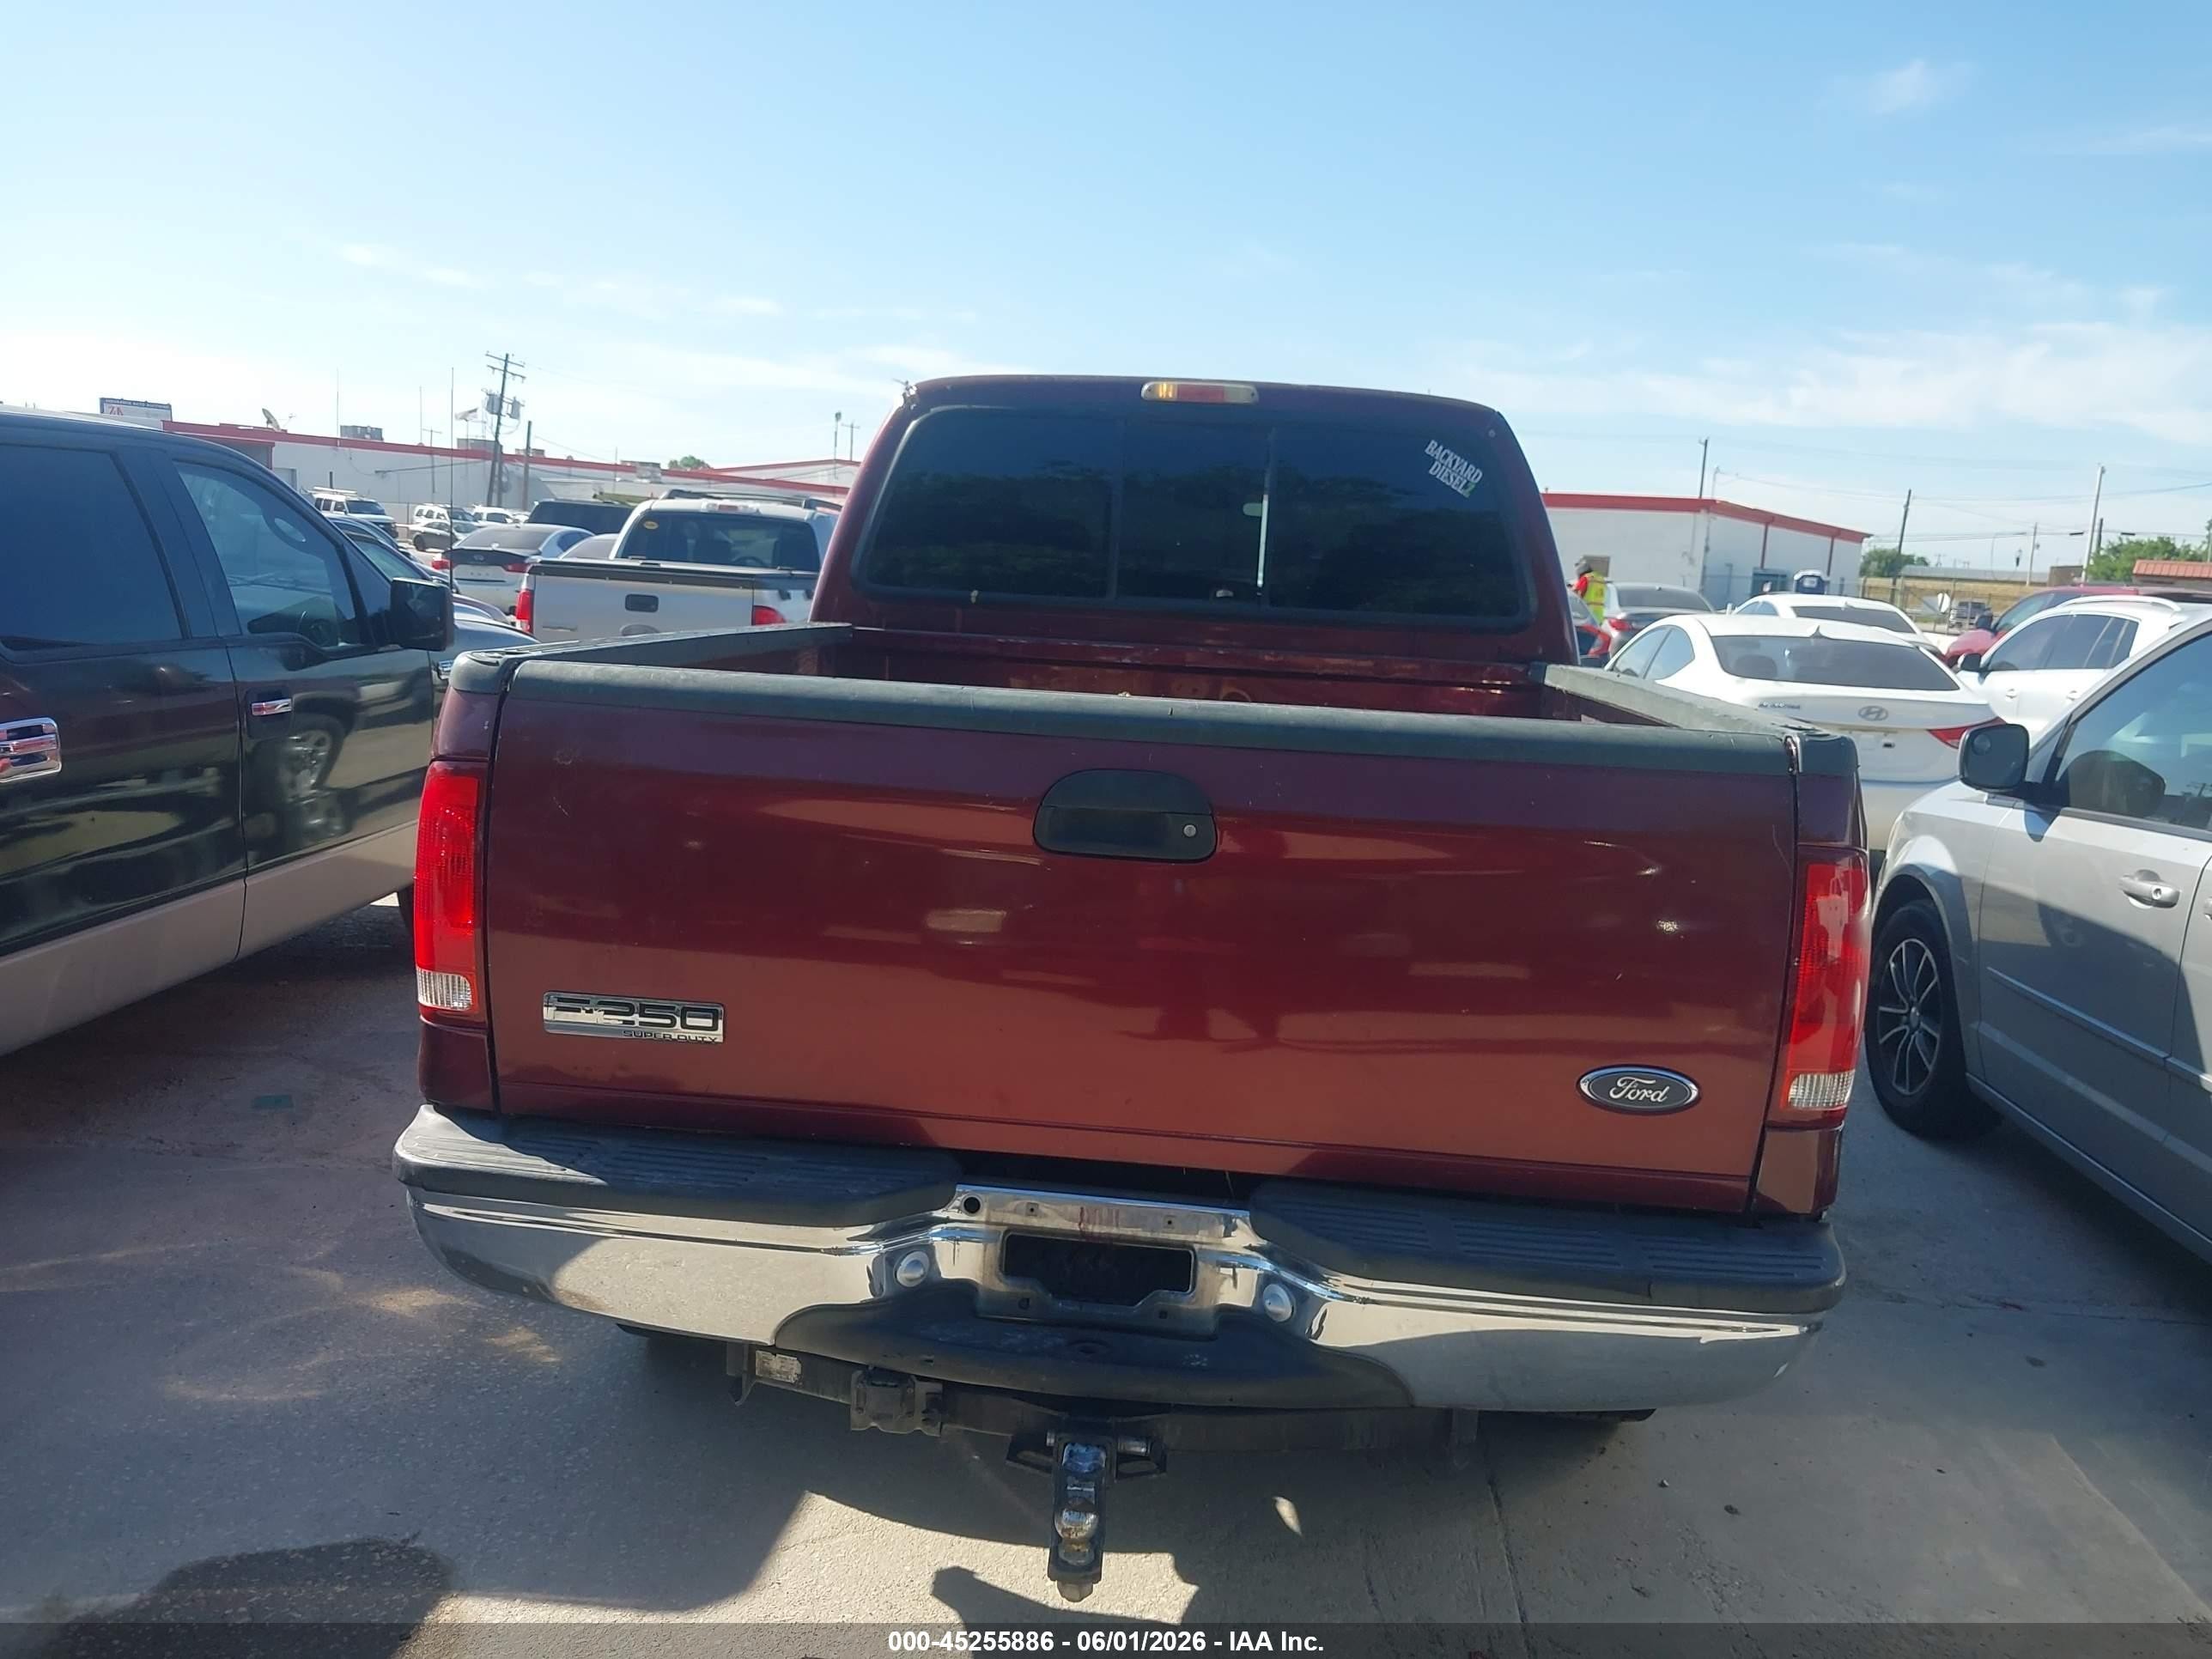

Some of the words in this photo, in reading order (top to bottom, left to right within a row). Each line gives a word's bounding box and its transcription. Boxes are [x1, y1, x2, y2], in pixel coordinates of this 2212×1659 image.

[1425, 440, 1483, 483] BACKYARD
[547, 997, 720, 1032] F-250
[623, 1030, 673, 1041] SUPER
[678, 1035, 718, 1043] DUTY
[1609, 1076, 1670, 1103] Ford
